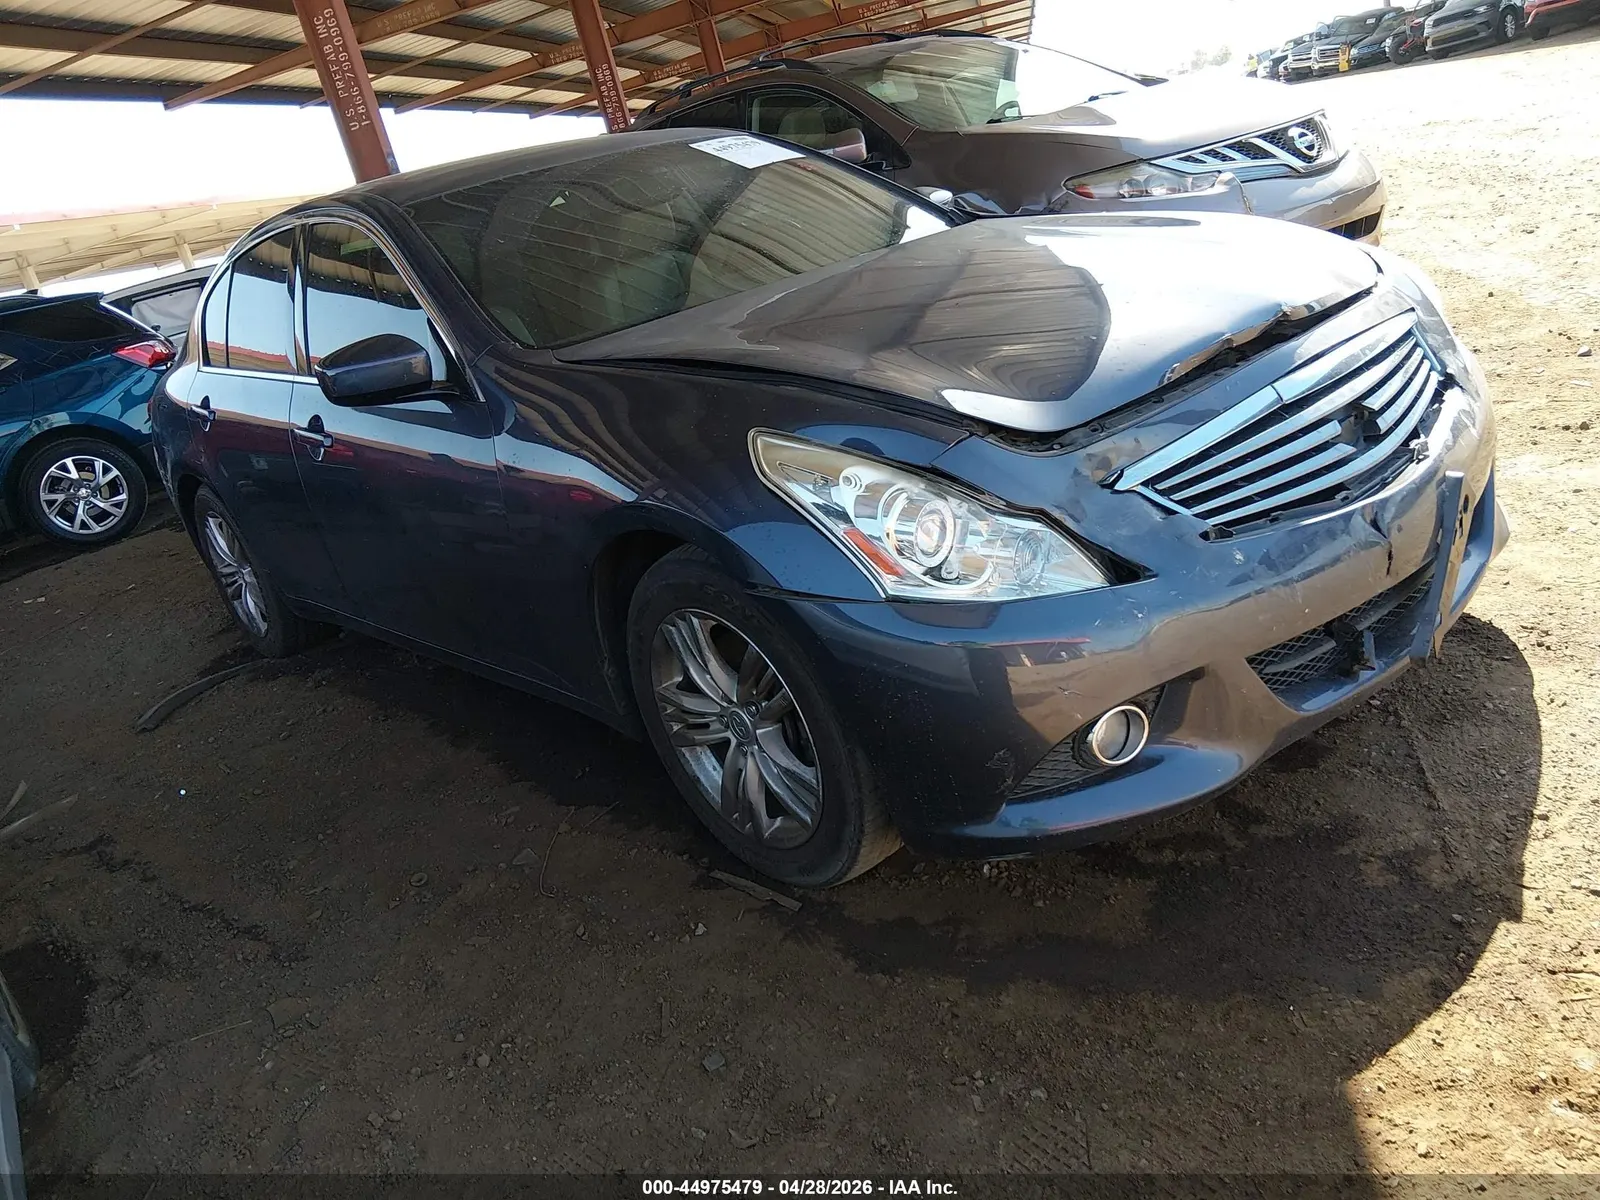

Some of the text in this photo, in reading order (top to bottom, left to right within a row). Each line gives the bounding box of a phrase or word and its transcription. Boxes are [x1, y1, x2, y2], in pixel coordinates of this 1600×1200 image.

[322, 45, 349, 98] PREFAB
[323, 8, 371, 127] 1-866-799-0969
[600, 85, 615, 118] PREFAB
